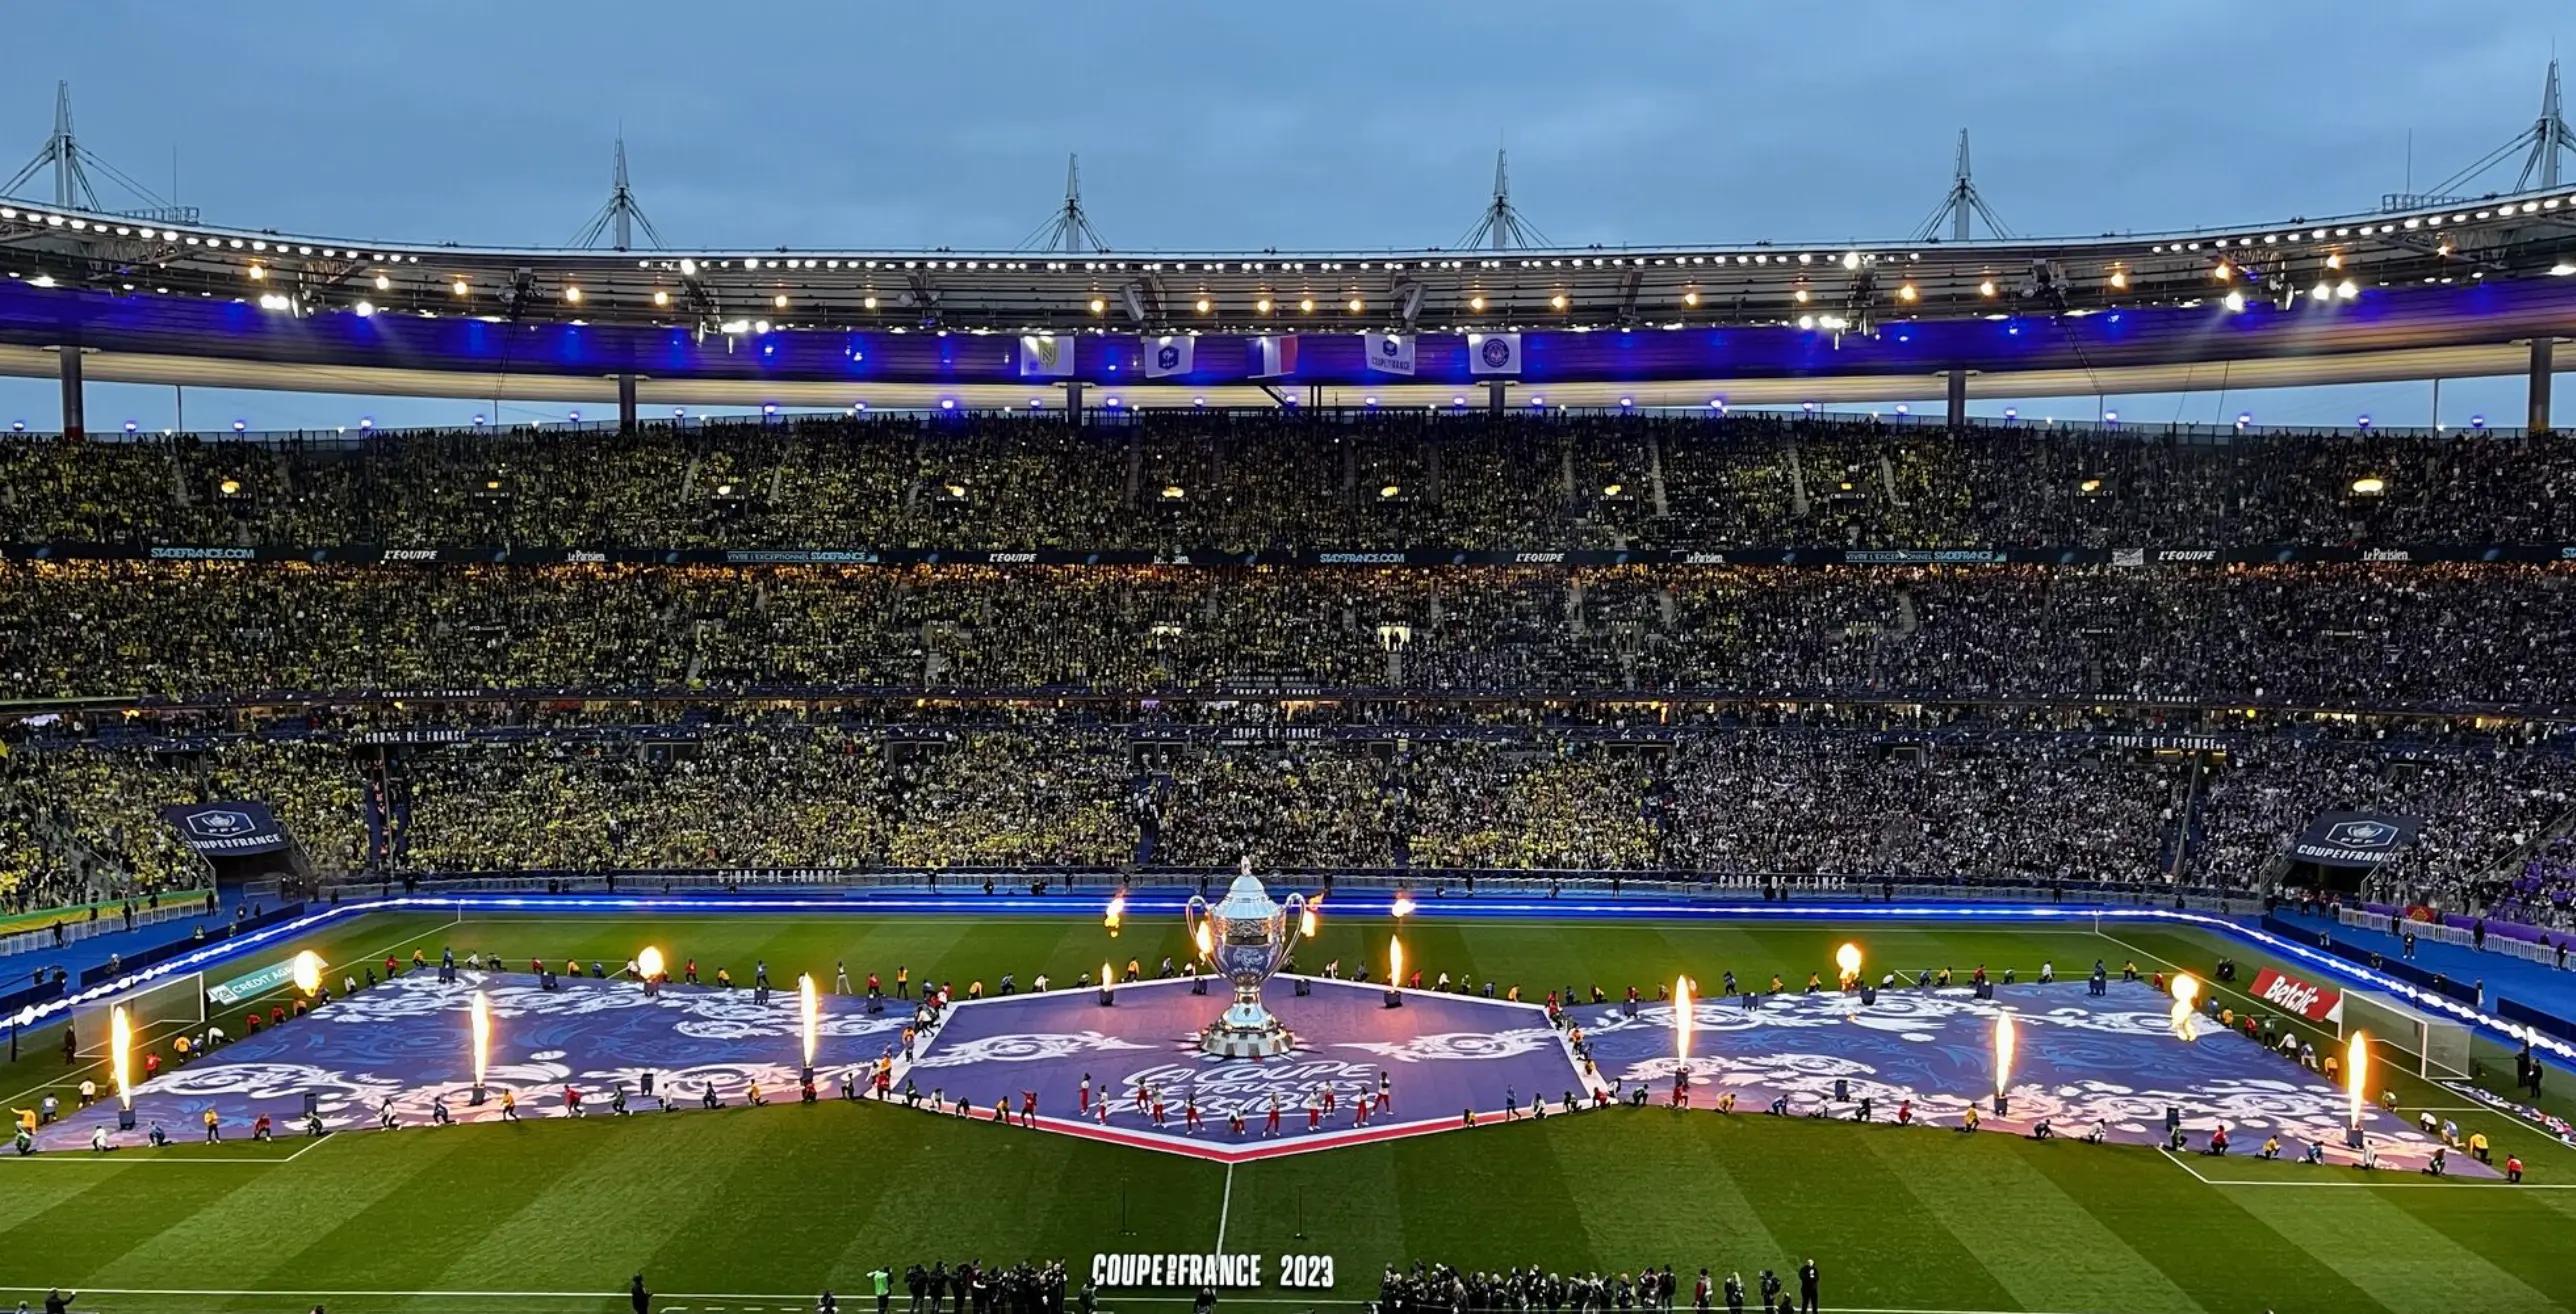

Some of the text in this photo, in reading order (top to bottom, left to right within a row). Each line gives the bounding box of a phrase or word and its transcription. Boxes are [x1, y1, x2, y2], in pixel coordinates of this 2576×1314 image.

[2263, 975, 2319, 1015] Betclic
[1194, 1060, 1378, 1086] COUPE
[1193, 1081, 1298, 1096] TOUS
[1092, 1254, 1164, 1286] COUPE
[1178, 1254, 1261, 1286] FRANCE
[1280, 1254, 1334, 1287] 2023
